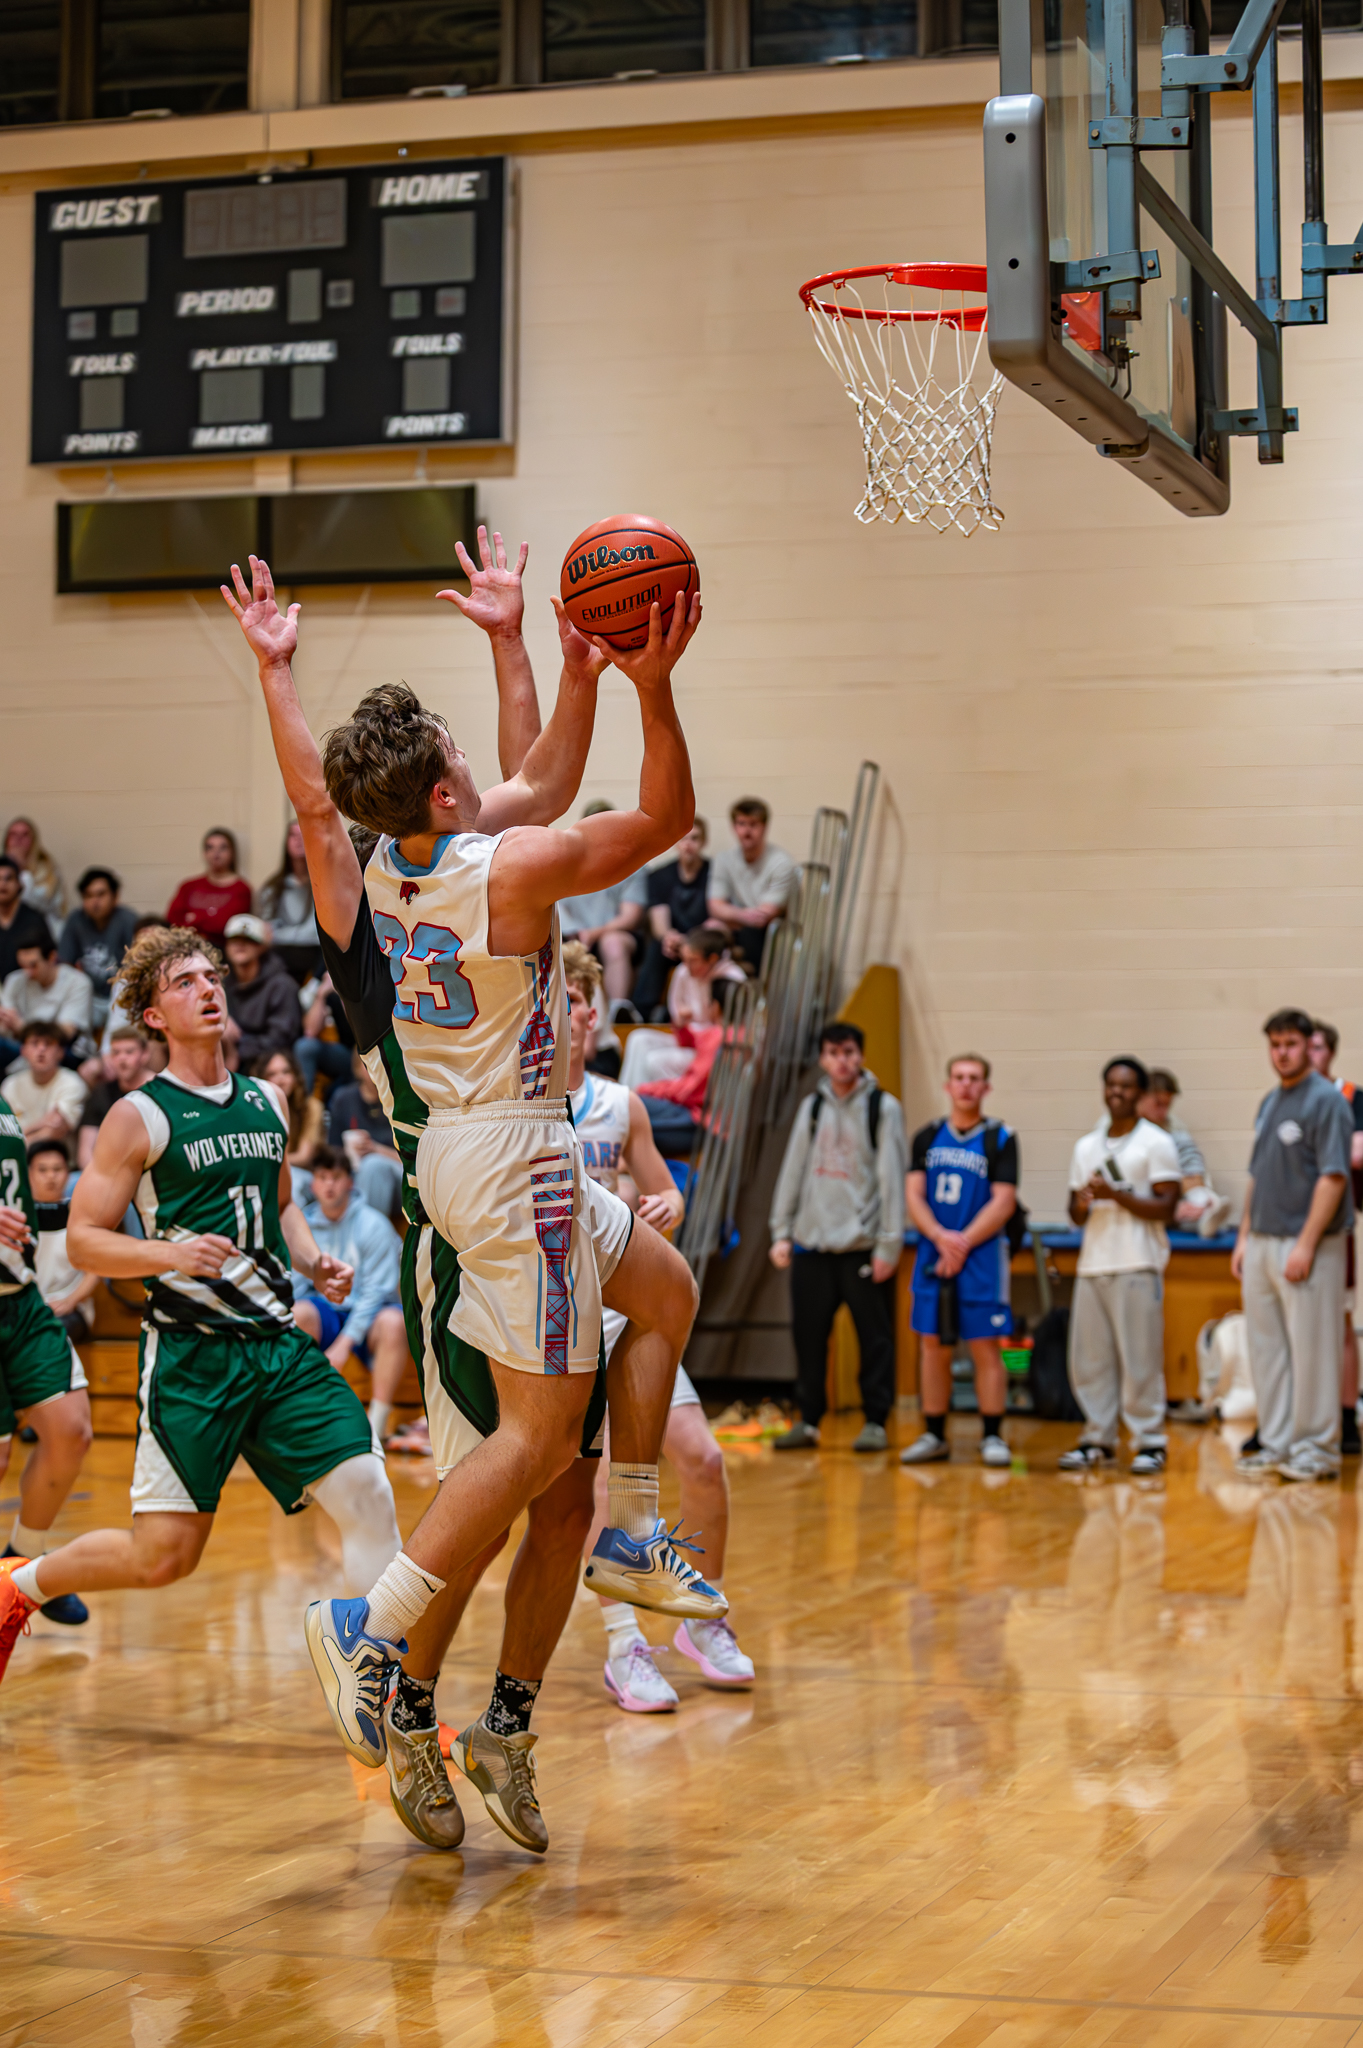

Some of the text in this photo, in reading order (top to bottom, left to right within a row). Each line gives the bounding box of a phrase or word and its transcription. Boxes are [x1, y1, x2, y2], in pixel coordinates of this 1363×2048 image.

[378, 171, 480, 207] HOME
[51, 195, 160, 231] GUEST
[176, 286, 276, 317] PERIOD
[391, 332, 463, 357] FOULS
[69, 352, 136, 376] FOULS
[191, 424, 269, 448] MATCH
[385, 412, 465, 438] POINTS
[63, 431, 139, 455] POINTS
[566, 544, 656, 585] Wilson
[581, 583, 662, 621] EVOLUTION
[373, 909, 479, 1029] 23
[183, 1131, 284, 1172] WOLVERINES
[935, 1172, 963, 1205] 13
[228, 1185, 265, 1249] 11
